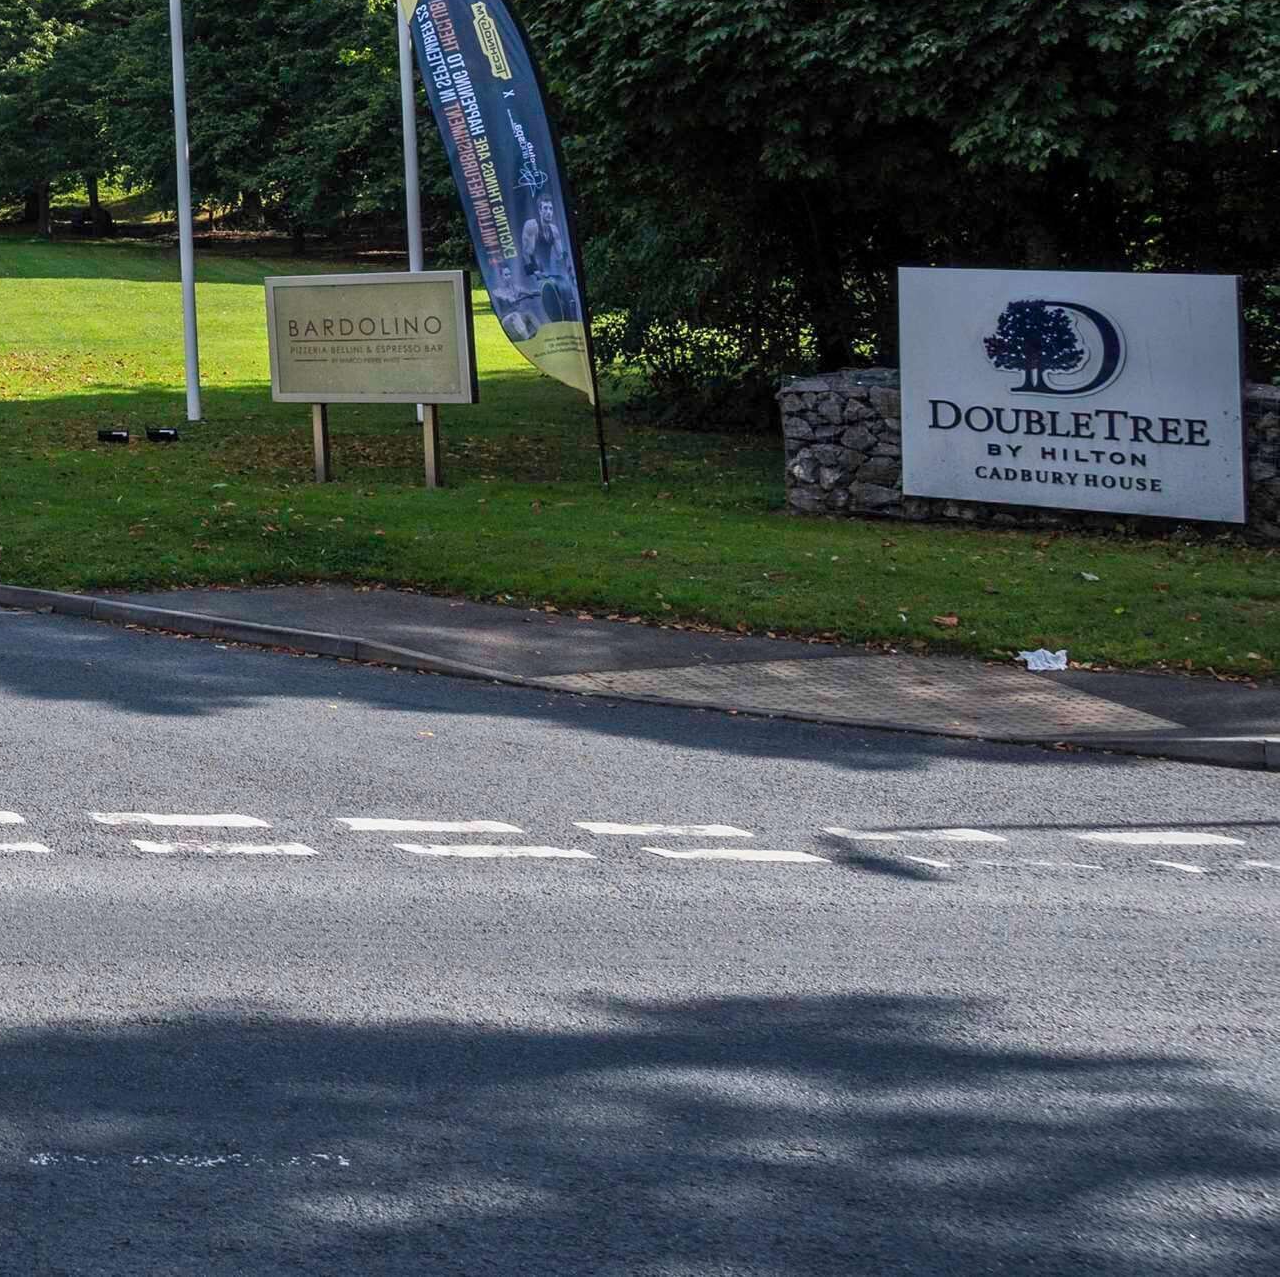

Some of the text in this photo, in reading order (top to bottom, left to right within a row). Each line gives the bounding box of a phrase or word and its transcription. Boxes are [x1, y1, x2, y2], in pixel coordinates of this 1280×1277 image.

[289, 316, 442, 337] BARDOLINO
[291, 346, 327, 355] PIZZERIA
[331, 346, 364, 354] BELLINI
[375, 344, 421, 354] ESPRESSO
[424, 344, 444, 353] BAR
[987, 443, 1147, 467] BY HILTON
[975, 465, 1163, 492] CADBURY HOUSE
